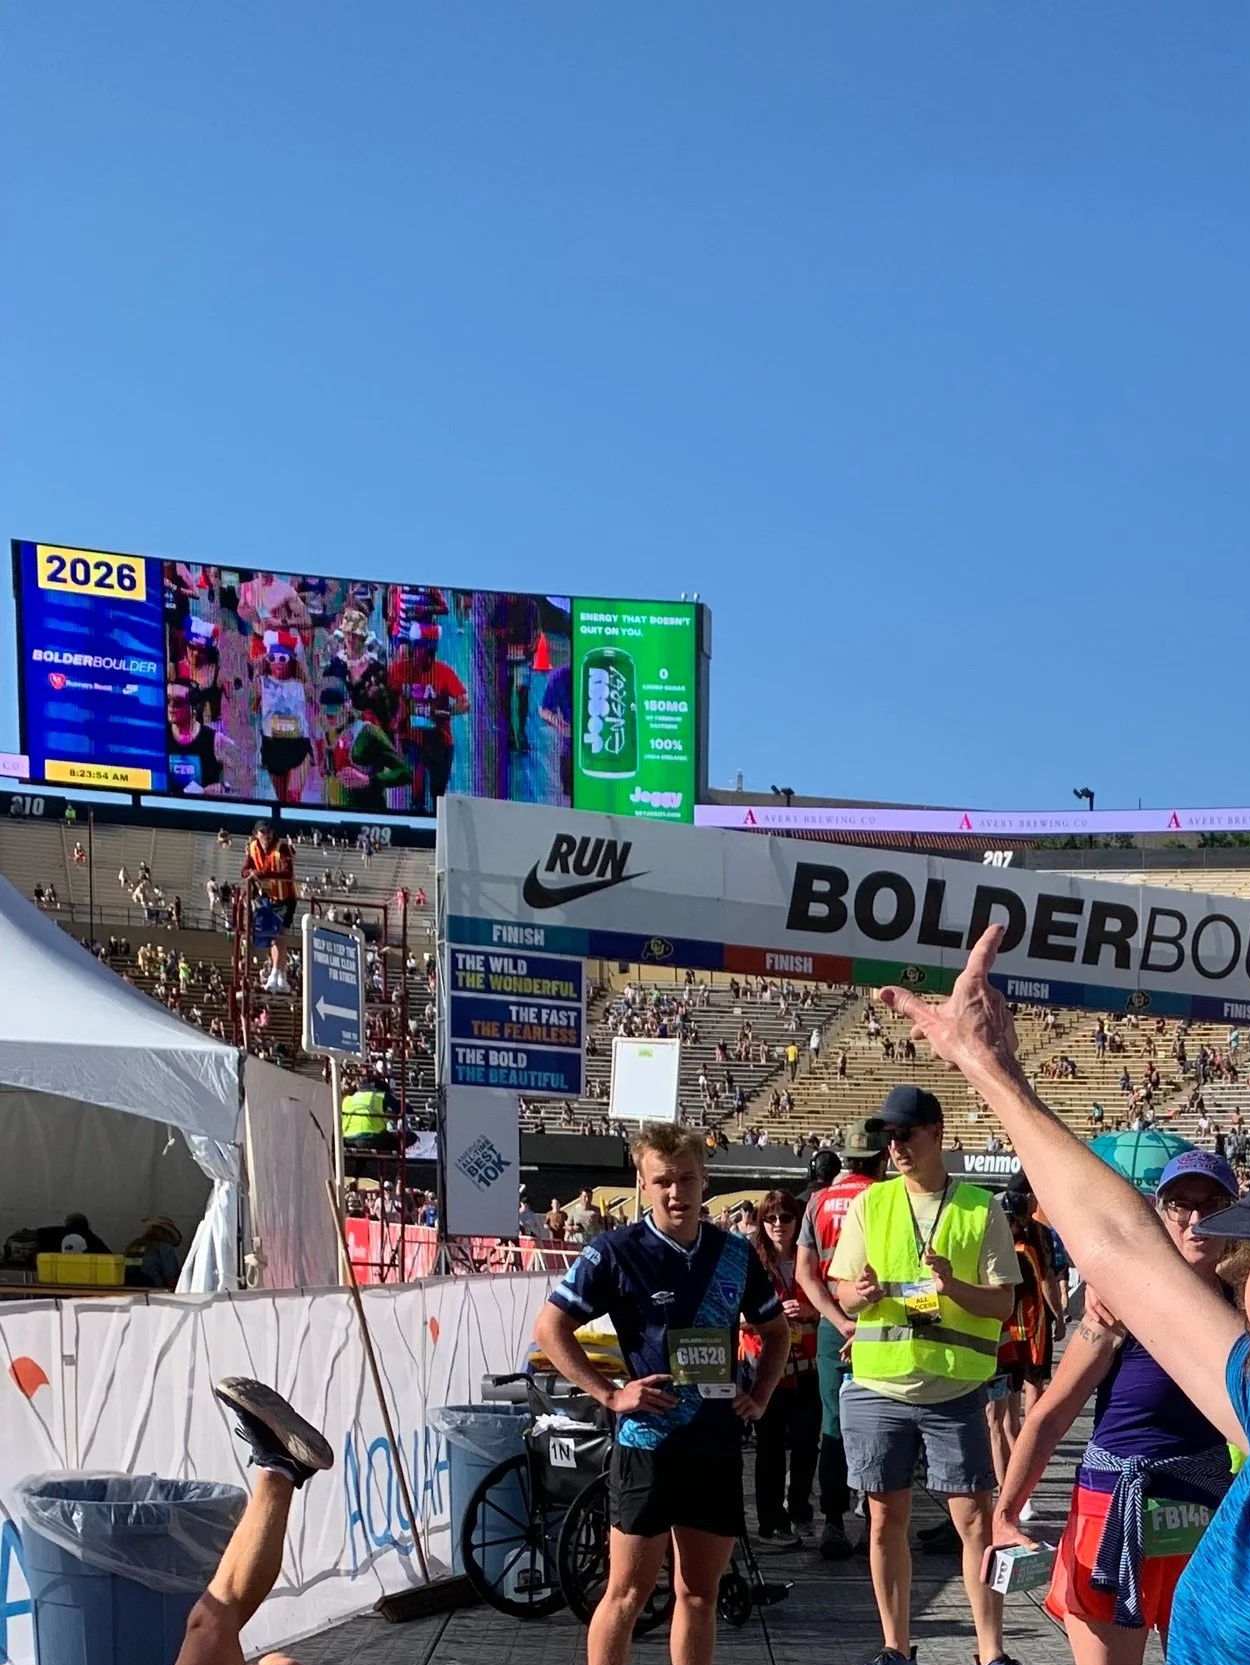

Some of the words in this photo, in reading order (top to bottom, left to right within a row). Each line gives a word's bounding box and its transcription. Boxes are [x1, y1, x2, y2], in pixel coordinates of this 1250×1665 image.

[46, 554, 138, 592] 2026
[579, 612, 618, 623] ENERGY
[621, 615, 647, 625] THAT
[649, 616, 691, 627] DOESN'T
[579, 625, 602, 635] QUIT
[603, 626, 619, 636] ON
[620, 627, 643, 637] YOU.
[32, 649, 157, 674] BOLDERBOULDER
[659, 668, 669, 680] 0
[643, 700, 688, 713] 150MG
[649, 738, 683, 751] 100%
[69, 768, 109, 780] 8:23:54
[112, 772, 129, 782] AM
[629, 786, 683, 808] Joggy
[763, 814, 799, 824] AVERY
[803, 815, 857, 825] BREWING
[979, 818, 1015, 828] AVERY
[1019, 819, 1070, 828] BREWING
[1187, 815, 1223, 826] AVERY
[544, 832, 633, 881] RUN
[982, 851, 1014, 869] 207
[492, 924, 546, 947] FINISH
[456, 953, 484, 971] THE
[489, 956, 527, 975] WILD
[765, 953, 814, 975] FINISH
[456, 972, 484, 989] THE
[489, 974, 577, 998] WONDERFUL
[1007, 979, 1051, 1000] FINISH
[509, 1005, 537, 1022] THE
[541, 1008, 577, 1027] FAST
[472, 1020, 499, 1038] THE
[504, 1023, 577, 1044] FEARLESS
[456, 1048, 484, 1064] THE
[489, 1050, 527, 1068] BOLD
[456, 1066, 484, 1082] THE
[489, 1069, 568, 1089] BEAUTIFUL
[466, 1144, 498, 1178] BEST
[477, 1151, 512, 1188] 10K
[963, 1154, 1021, 1173] venmo
[676, 1347, 726, 1366] GH328
[550, 1439, 571, 1461] 1N
[1152, 1504, 1209, 1531] FB146
